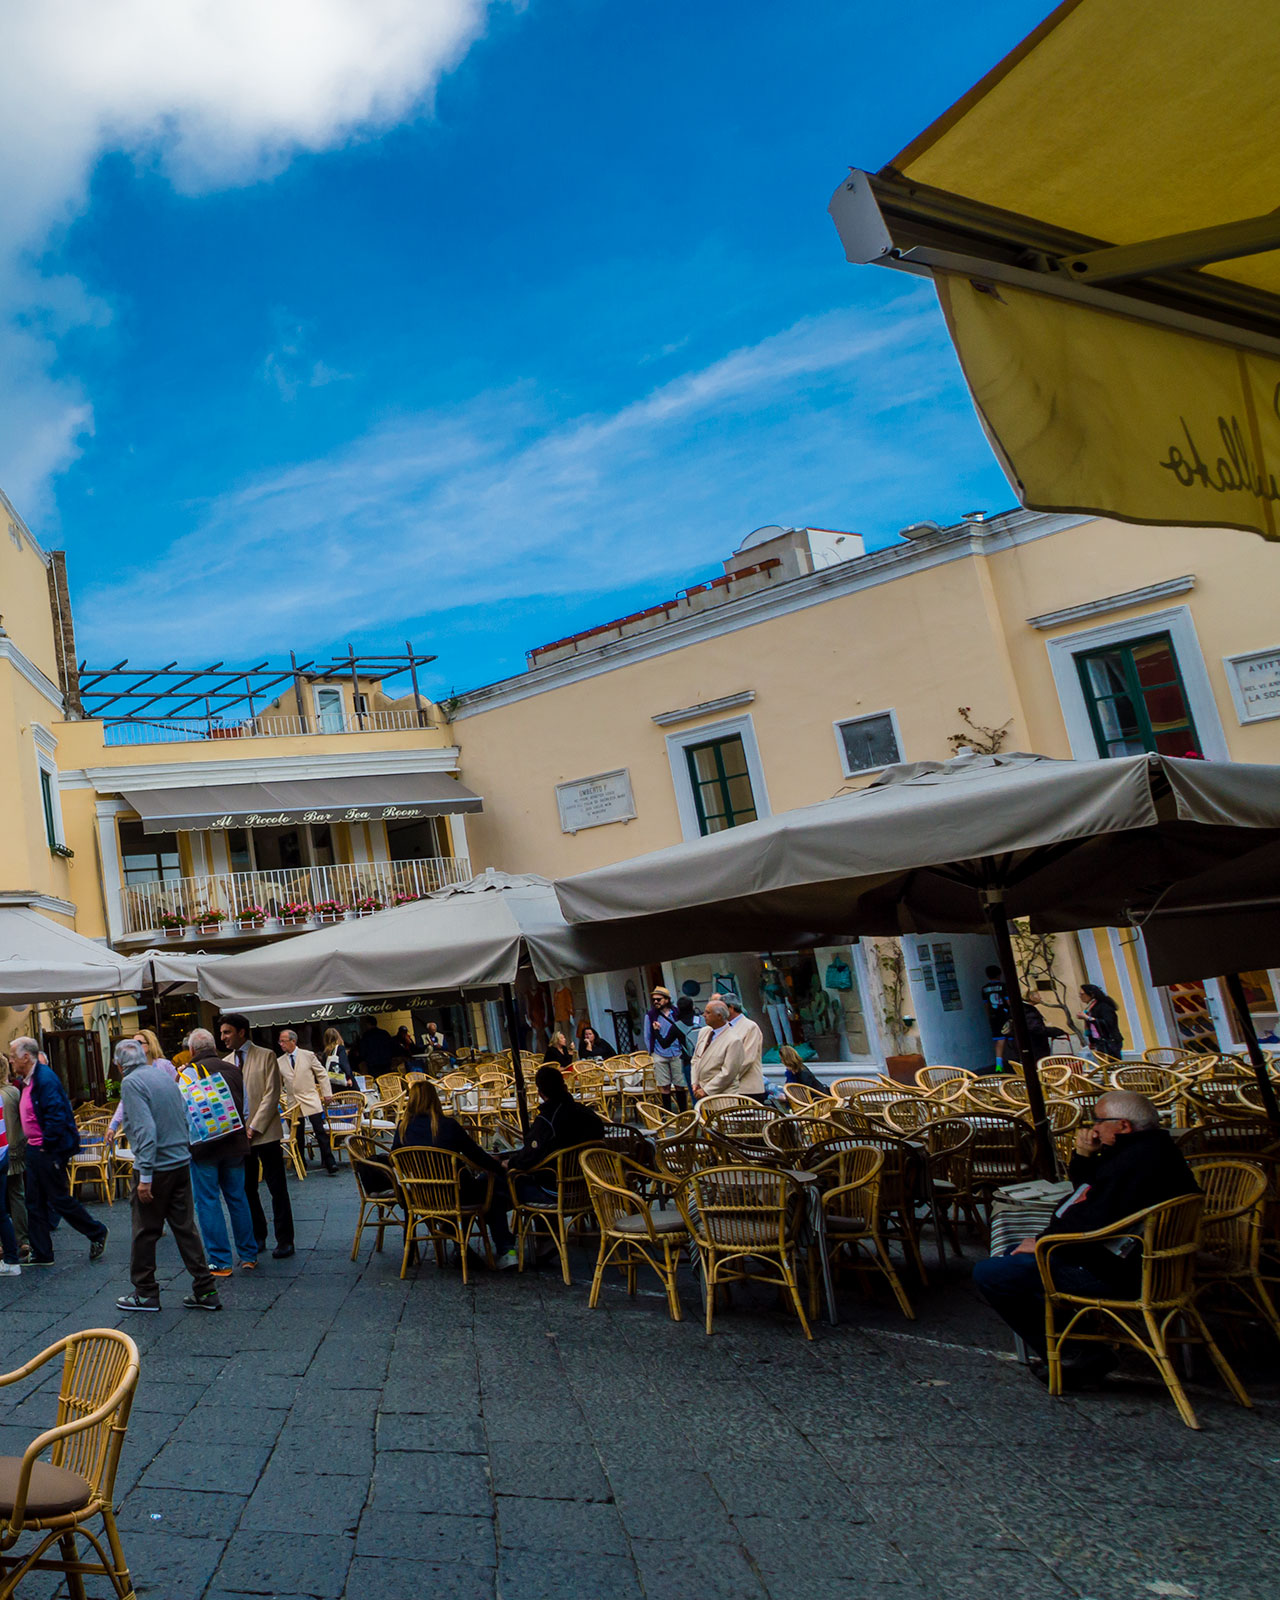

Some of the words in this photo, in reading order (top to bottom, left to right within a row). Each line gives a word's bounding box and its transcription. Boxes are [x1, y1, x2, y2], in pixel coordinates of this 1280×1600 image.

[211, 815, 233, 828] Al
[245, 813, 292, 826] Piccolo
[302, 810, 335, 823] Bar
[344, 808, 370, 820] Tea
[382, 806, 422, 818] Room
[311, 1004, 335, 1018] Al
[346, 1000, 393, 1015] Piccolo
[406, 996, 435, 1008] Bar
